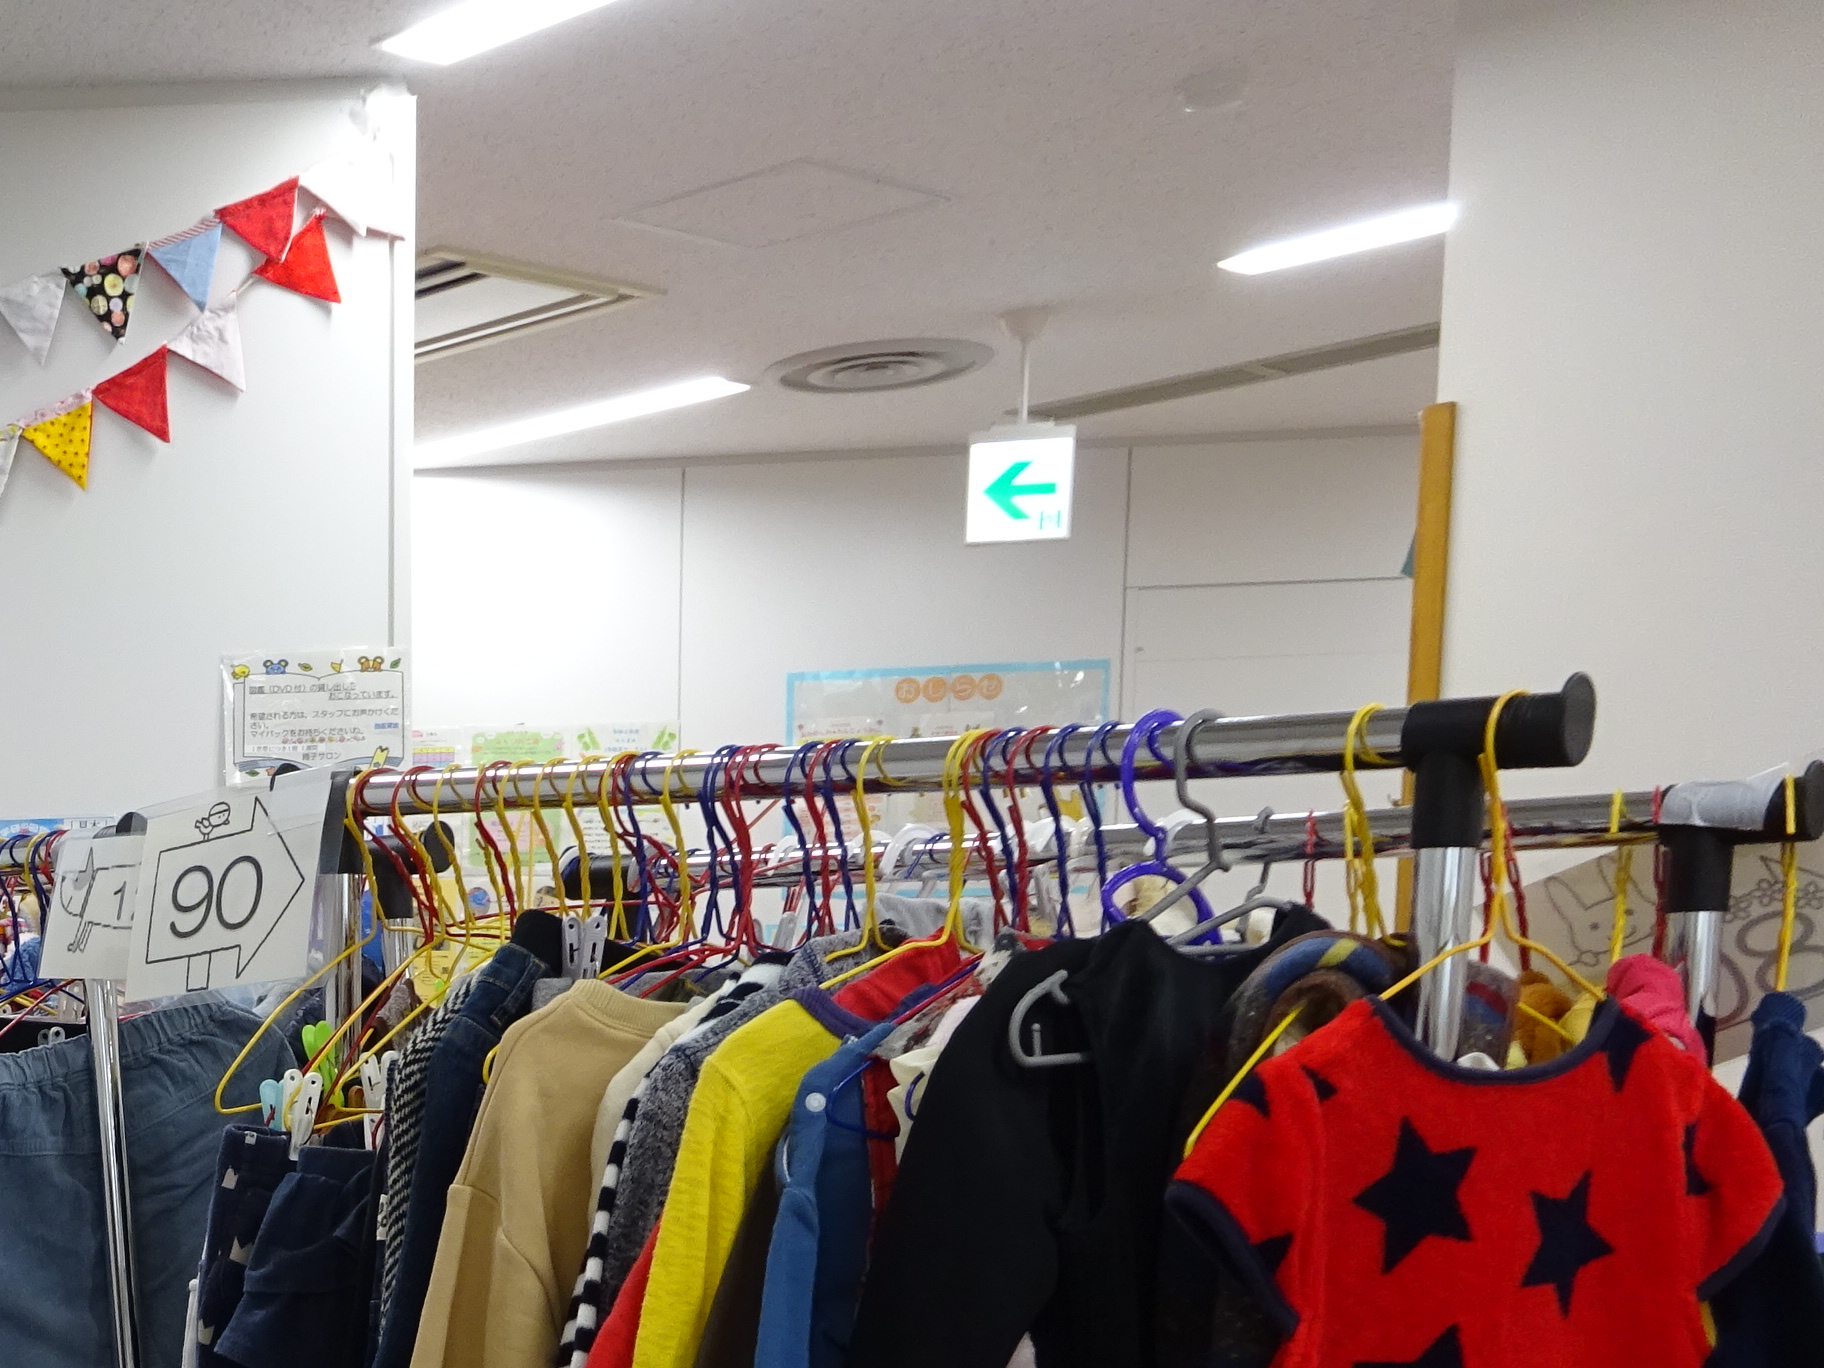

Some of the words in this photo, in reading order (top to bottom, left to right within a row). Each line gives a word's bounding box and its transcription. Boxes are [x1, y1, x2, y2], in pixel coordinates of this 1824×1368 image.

[896, 674, 1004, 703] おしらせ
[171, 854, 264, 939] 90
